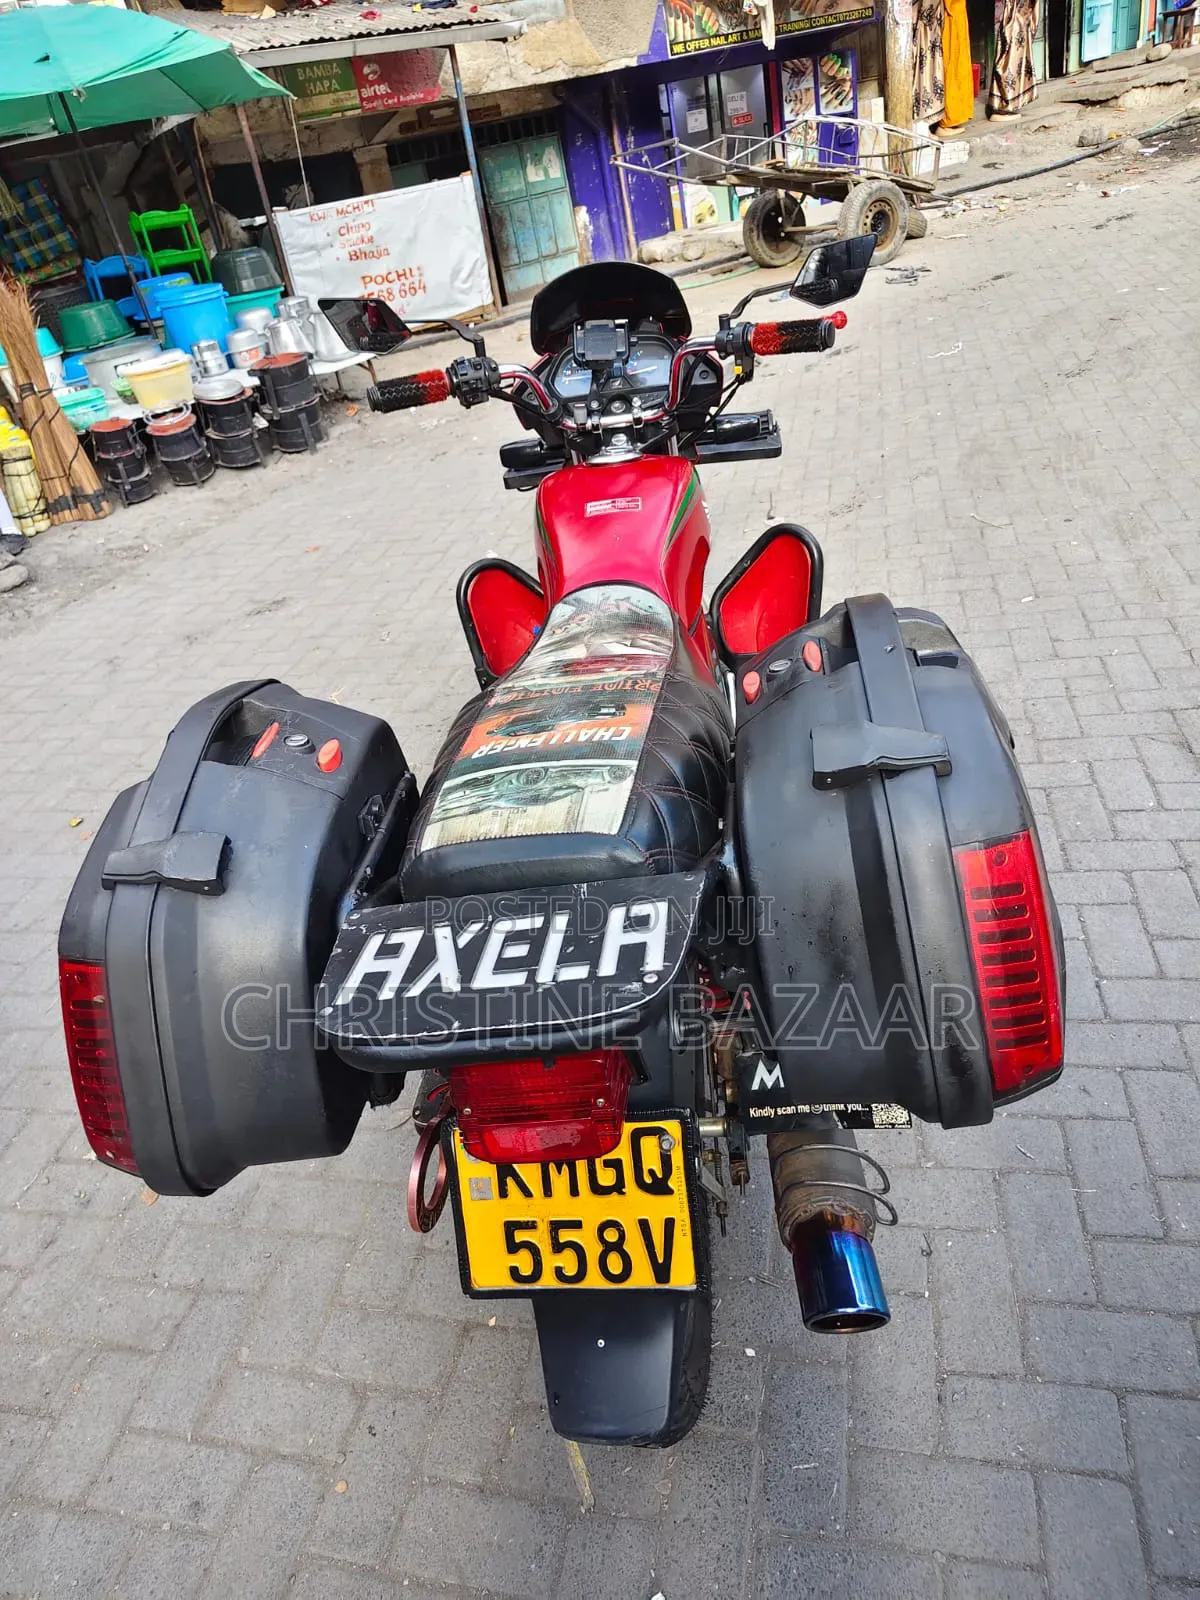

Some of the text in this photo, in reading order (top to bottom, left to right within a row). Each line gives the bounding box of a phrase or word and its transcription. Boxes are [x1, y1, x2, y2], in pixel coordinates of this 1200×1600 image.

[686, 39, 710, 51] OFFER
[710, 36, 728, 46] NAIL
[727, 33, 741, 43] ART
[742, 32, 748, 40] &
[296, 63, 342, 80] BAMBA
[305, 79, 341, 95] HAPA
[360, 82, 392, 98] airtel
[398, 279, 427, 299] 664
[471, 726, 634, 760] CHALLENGER
[333, 900, 669, 1006] AXELA
[749, 1106, 775, 1118] Kindly
[776, 1105, 797, 1115] scan
[797, 1103, 810, 1113] me
[823, 1103, 846, 1112] thank
[496, 1127, 675, 1199] KMGQ
[503, 1216, 676, 1284] 558V
